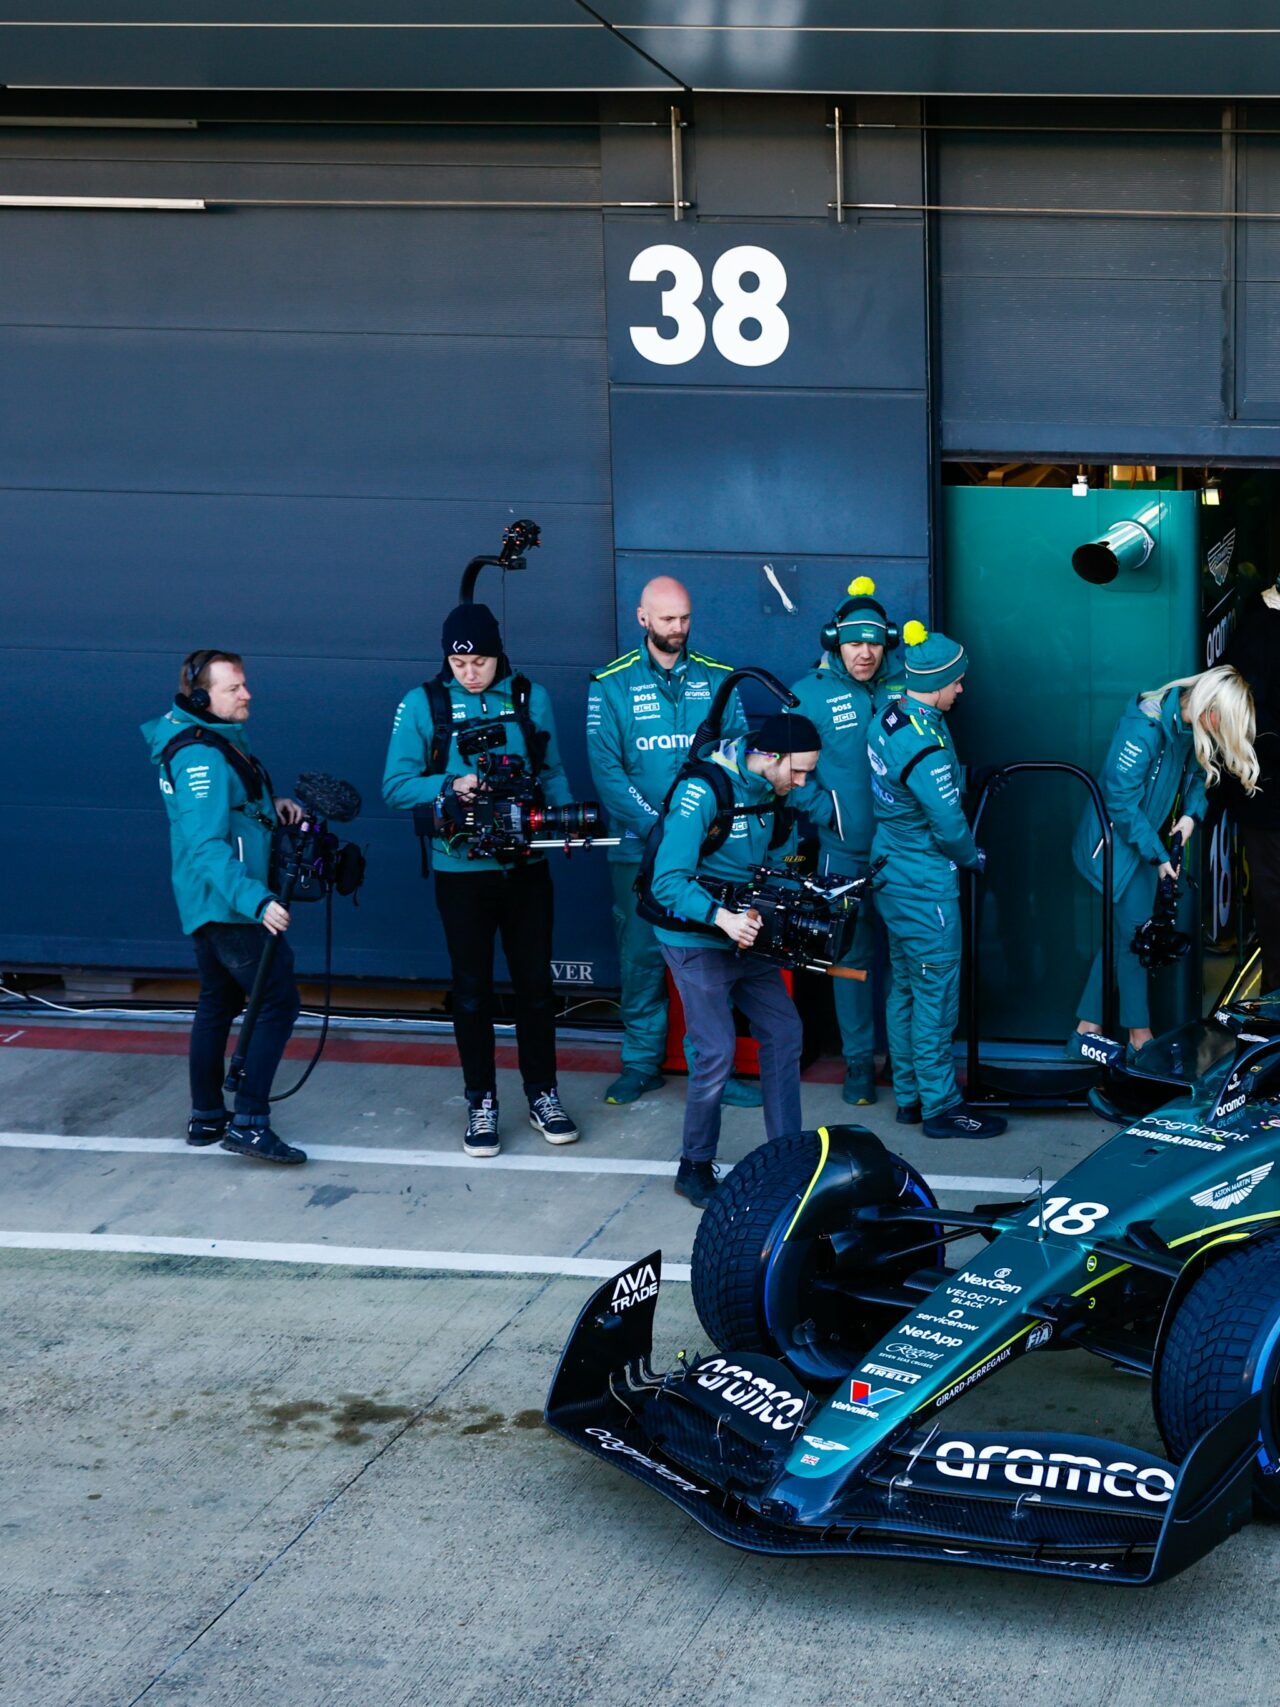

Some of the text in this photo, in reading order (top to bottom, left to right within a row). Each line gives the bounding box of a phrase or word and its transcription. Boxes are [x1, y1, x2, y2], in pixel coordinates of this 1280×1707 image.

[629, 244, 790, 367] 38
[633, 693, 657, 702] BOSS
[633, 702, 661, 714] JCB
[831, 702, 852, 713] BOSS
[832, 711, 857, 724] JCB
[550, 963, 593, 981] VER
[1081, 1044, 1108, 1065] BOSS
[1216, 1094, 1246, 1117] aramco
[1126, 1128, 1227, 1152] BOMBARDIER
[1142, 1117, 1251, 1142] cognizant
[1214, 1176, 1251, 1200] ASTON MARTIN
[1027, 1196, 1110, 1236] 18
[612, 1264, 657, 1301] AVA
[957, 1271, 1023, 1295] NexGen
[611, 1282, 658, 1314] TRADE
[946, 1287, 1008, 1308] VELOCITY
[951, 1297, 985, 1310] BLACK
[916, 1312, 980, 1332] servicenow
[898, 1324, 964, 1348] NetApp
[878, 1352, 896, 1361] SEVEN
[860, 1363, 922, 1385] PIRELLI
[936, 1347, 1012, 1408] GIRARD-PERREGAUX
[698, 1358, 804, 1431] aramco
[831, 1400, 880, 1421] Valvoline
[935, 1440, 1176, 1503] aramco
